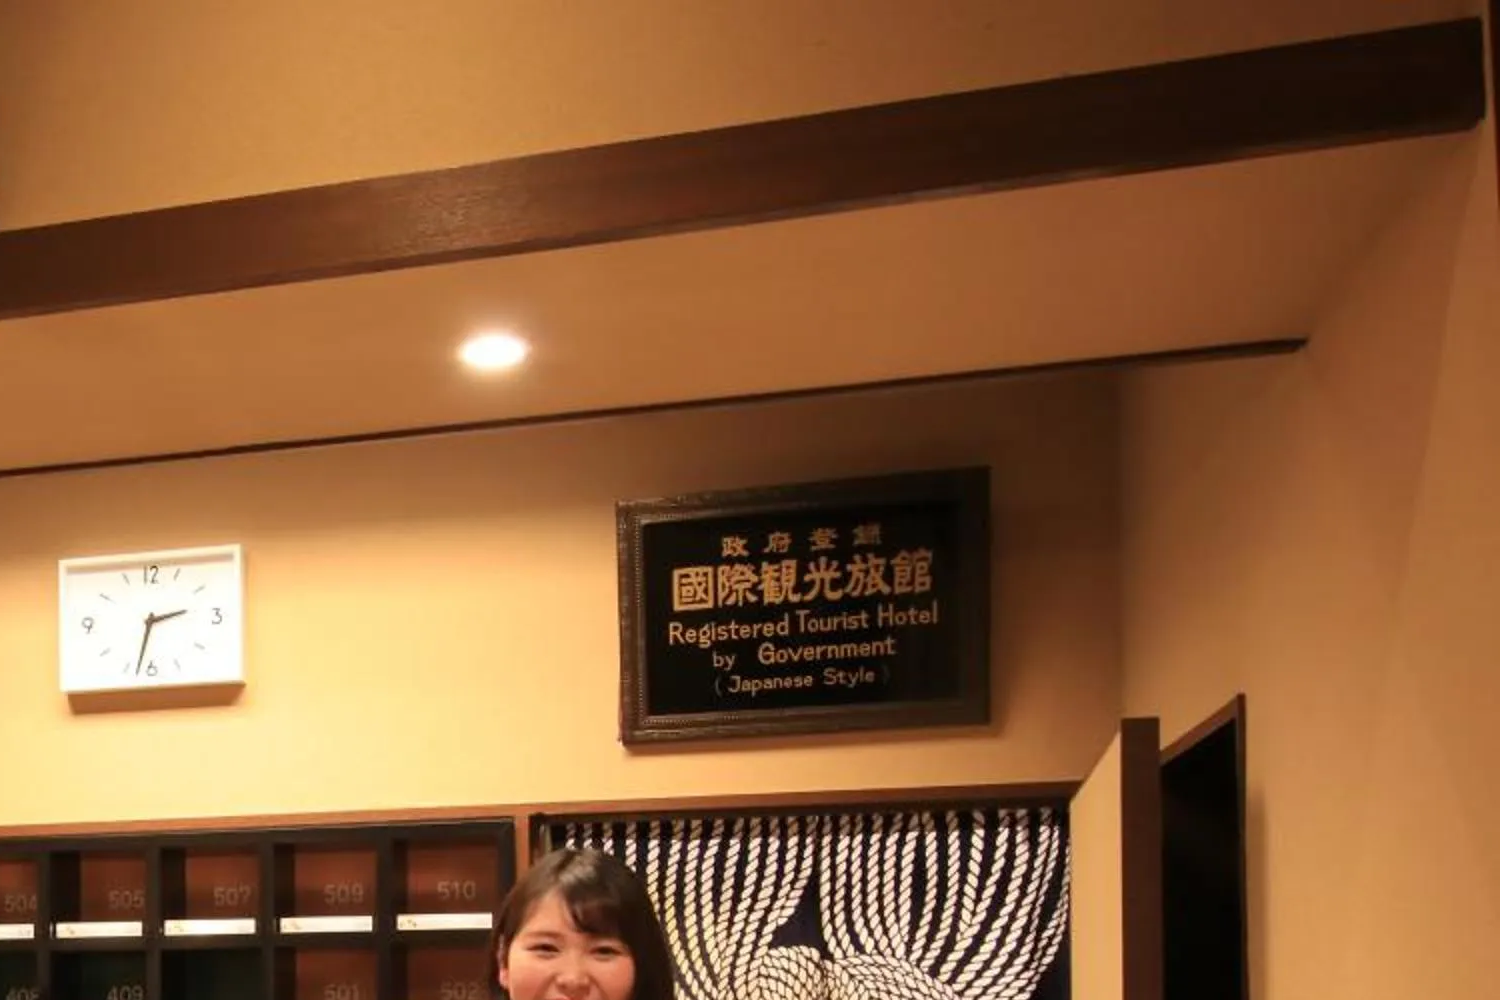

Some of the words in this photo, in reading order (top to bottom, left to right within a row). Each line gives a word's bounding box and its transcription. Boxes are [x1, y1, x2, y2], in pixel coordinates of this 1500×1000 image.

[143, 564, 160, 585] 12
[672, 547, 934, 612] 國際観光旅館
[81, 616, 95, 634] 9
[211, 607, 223, 625] 3
[668, 613, 790, 648] Registered
[797, 605, 870, 635] Tourist
[877, 599, 938, 628] Hotel
[712, 651, 736, 671] by
[757, 635, 897, 666] Government
[145, 659, 159, 677] 6
[108, 889, 145, 911] 505
[213, 886, 252, 906] 507
[437, 880, 477, 900] 510
